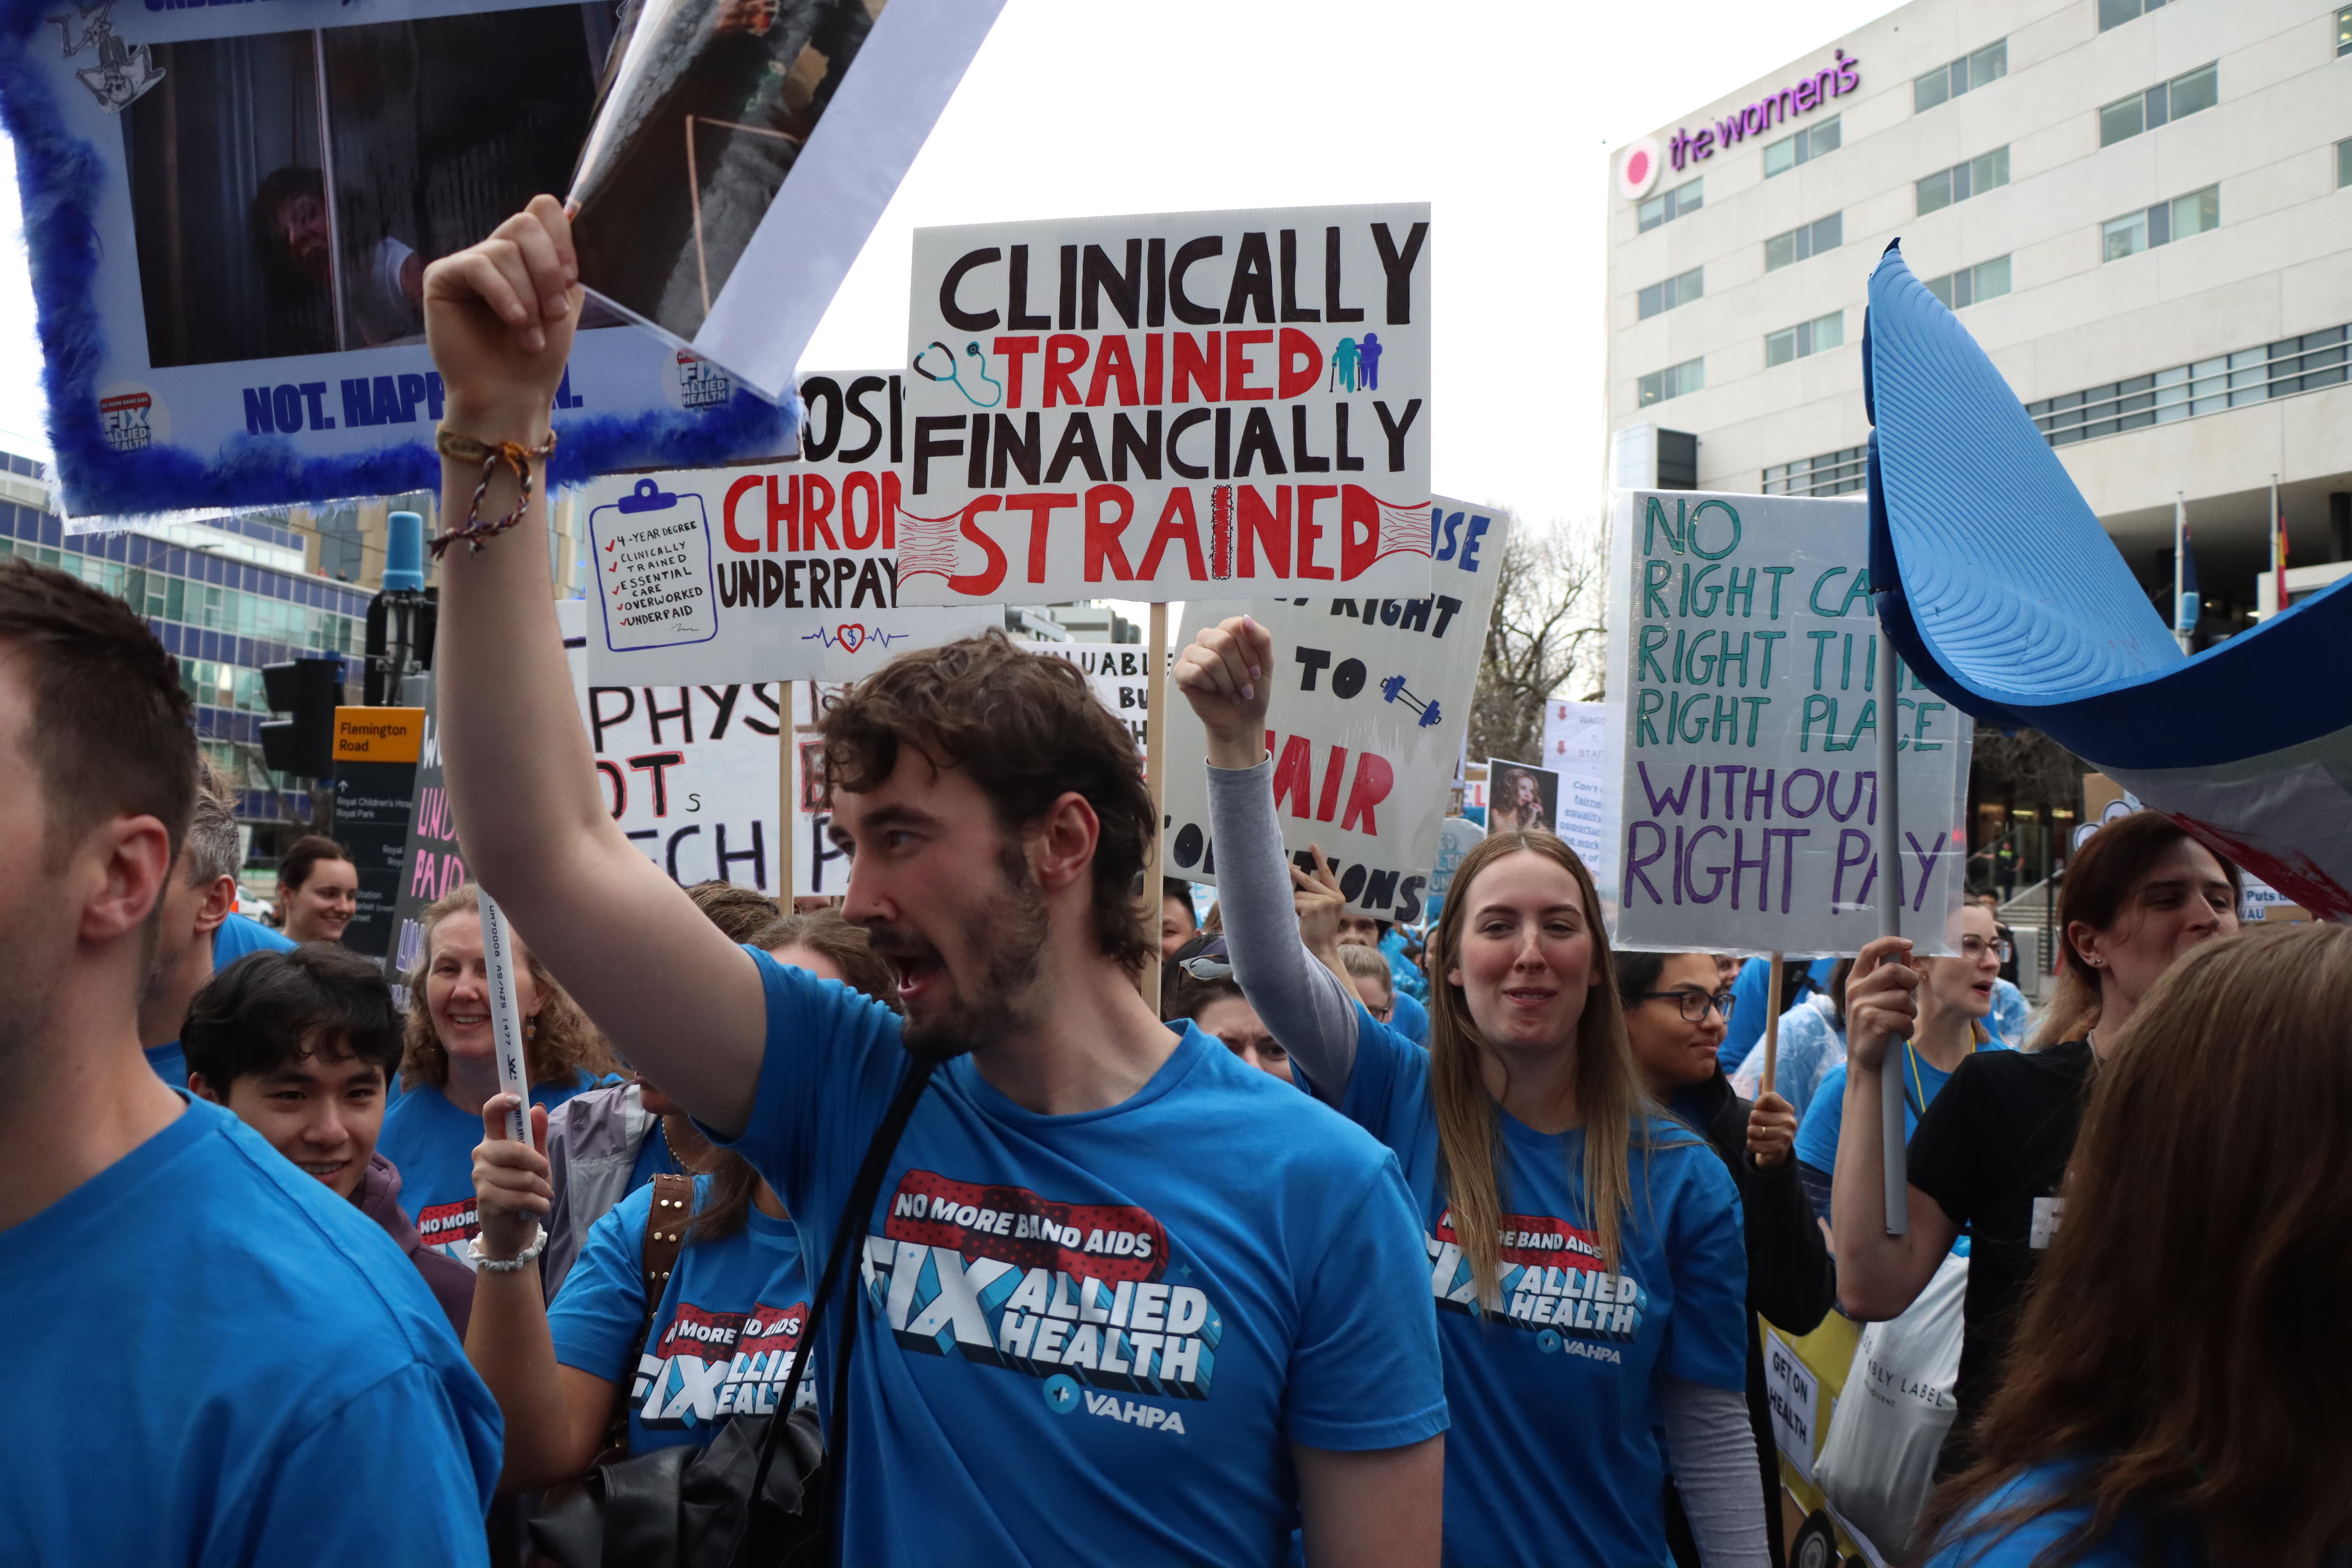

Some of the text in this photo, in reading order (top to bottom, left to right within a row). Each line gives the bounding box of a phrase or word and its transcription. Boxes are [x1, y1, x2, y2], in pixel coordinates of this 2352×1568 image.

[1669, 49, 1859, 171] the women's
[939, 222, 1430, 332] CLINICALLY
[683, 380, 725, 395] ALLIED
[993, 328, 1323, 408] TRAINED
[243, 382, 335, 436] NOT.
[683, 390, 725, 406] HEALTH
[103, 406, 146, 432] FIX
[106, 427, 147, 443] ALLIED
[111, 438, 148, 452] EALTH
[913, 399, 1422, 494] FINANCIALLY
[662, 521, 697, 536] DEGREE
[947, 484, 1382, 596] STRAINED
[1644, 497, 1741, 560] NO
[621, 541, 685, 563] CLINICALLY
[627, 554, 686, 573] TRAINED
[620, 566, 691, 590] ESSENTIAL
[632, 584, 662, 597] CARE
[1644, 560, 1794, 620] RIGHT
[625, 587, 703, 610] OVERWORKED
[627, 605, 692, 626] UNDERPAID
[1295, 646, 1367, 699] TO
[1639, 625, 1786, 689] RIGHT
[341, 723, 407, 738] Flemington
[1637, 688, 1771, 748] RIGHT
[339, 739, 369, 752] Road
[337, 796, 356, 807] Royal
[358, 797, 393, 807] Children's
[1265, 730, 1394, 836] AIR
[1637, 761, 1876, 826] WITHOUT
[336, 808, 374, 819] Royal Park
[382, 844, 403, 855] Royal
[1623, 820, 1811, 915] RIGHT
[412, 849, 465, 901] PAID
[2247, 891, 2275, 901] Puts
[489, 905, 511, 1046] WM70008 AS/NZS 1477
[420, 1218, 440, 1234] NO
[895, 1193, 1152, 1258] NO MORE BAND AIDS
[1517, 1232, 1564, 1250] BAND
[1565, 1235, 1603, 1259] AIDS
[862, 1234, 1018, 1348] FIX
[1006, 1267, 1208, 1335] ALLIED
[1515, 1266, 1637, 1304] ALLIED
[678, 1319, 738, 1345] MORE
[761, 1318, 801, 1338] AIDS
[1509, 1292, 1634, 1333] HEALTH
[1000, 1310, 1201, 1383] HEALTH
[1564, 1339, 1621, 1364] VAHPA
[1773, 1351, 1807, 1403] GET ON
[1900, 1378, 1942, 1407] LABEL
[1084, 1391, 1186, 1435] VAHPA
[1770, 1386, 1807, 1445] HEALTH
